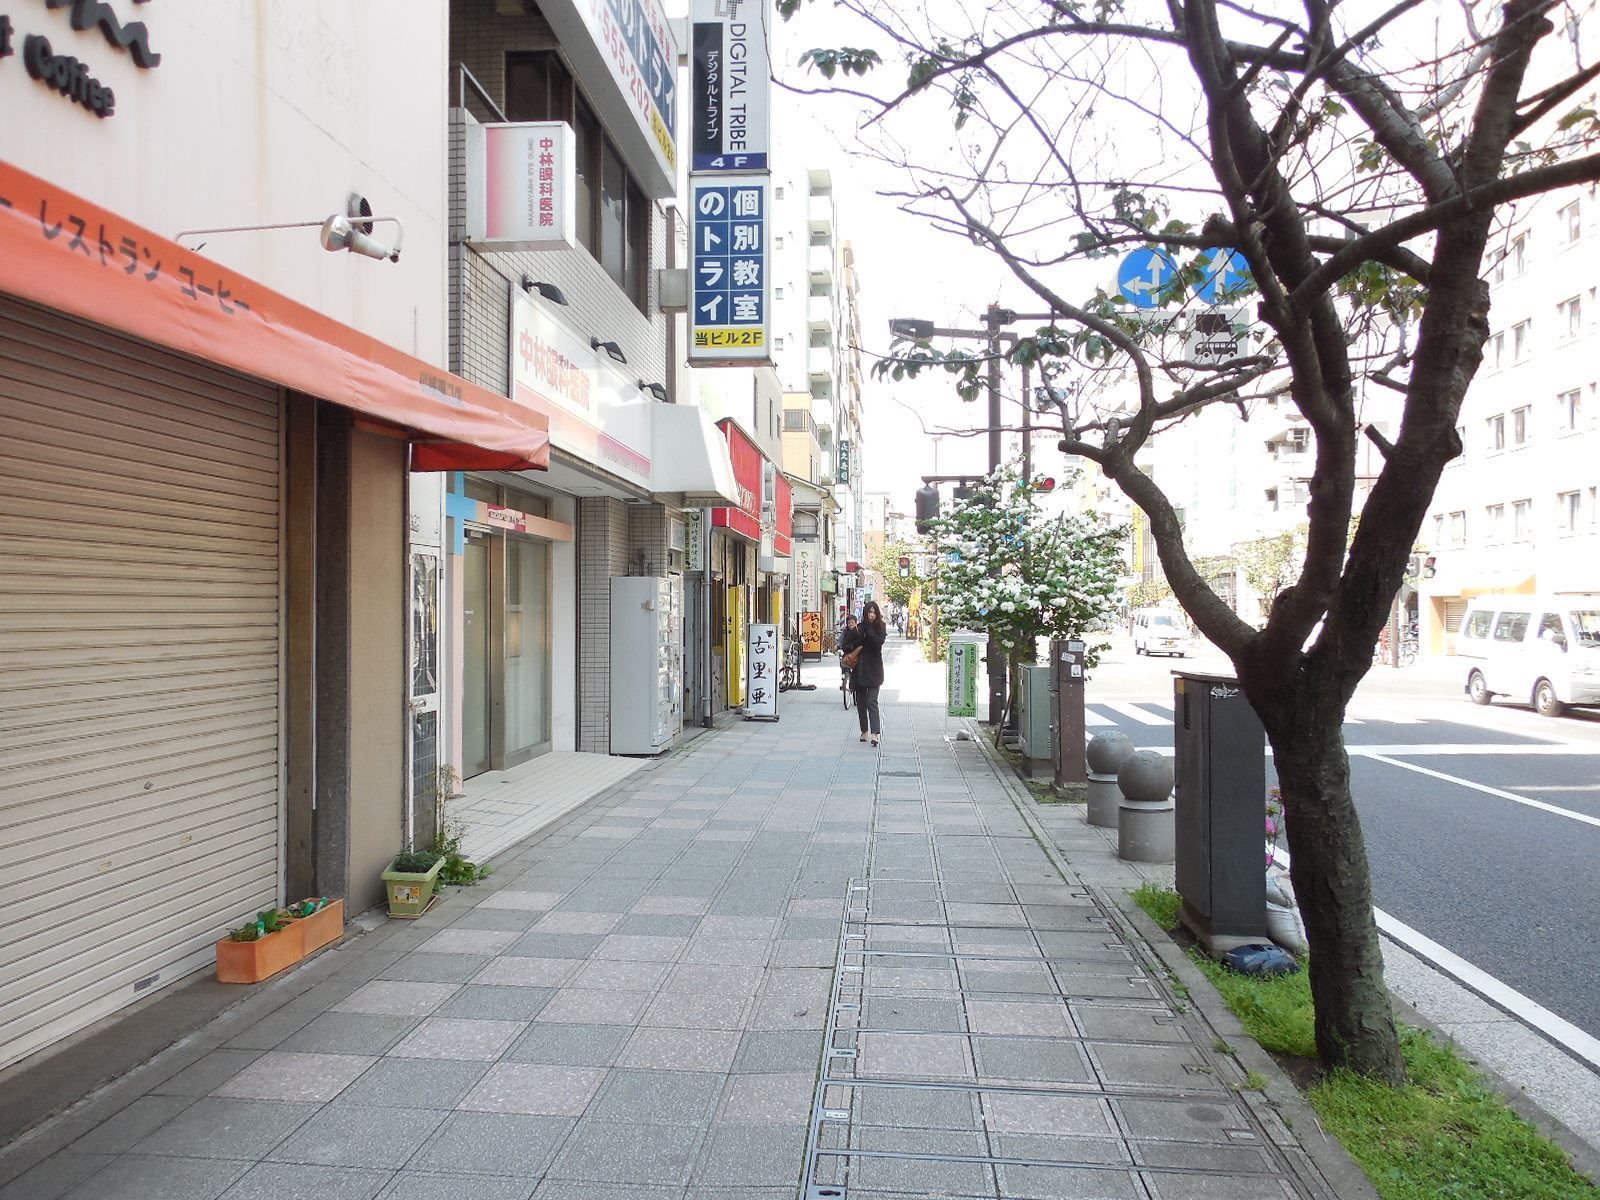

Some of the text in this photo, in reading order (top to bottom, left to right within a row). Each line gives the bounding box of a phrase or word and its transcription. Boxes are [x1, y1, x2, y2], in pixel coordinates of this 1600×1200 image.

[23, 33, 116, 119] Coffee
[730, 23, 746, 150] DIGITAL TRIBE
[539, 137, 554, 227] 中林眼科医院
[40, 199, 161, 282] レストラン
[178, 265, 250, 315] コーヒー
[699, 191, 726, 322] のトライ
[732, 189, 760, 322] 個別教室
[695, 331, 763, 346] 当ビル2F
[751, 635, 770, 705] 古里亜
